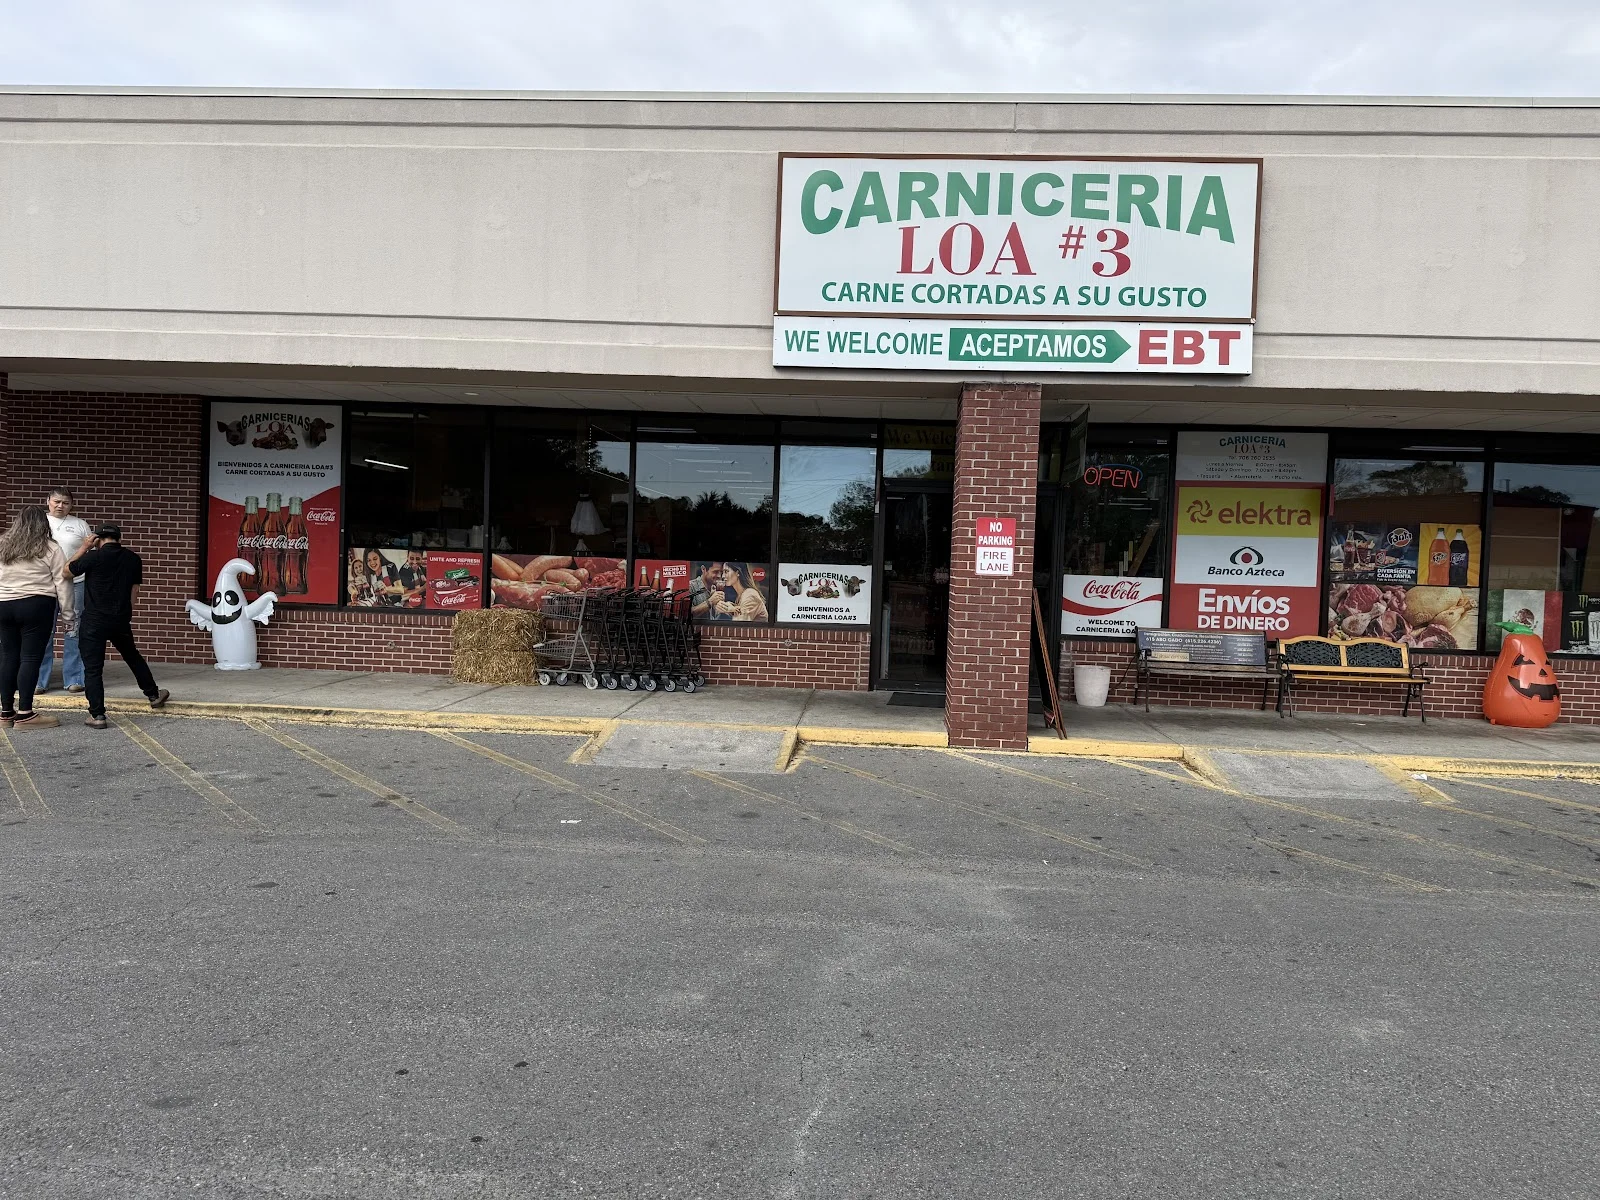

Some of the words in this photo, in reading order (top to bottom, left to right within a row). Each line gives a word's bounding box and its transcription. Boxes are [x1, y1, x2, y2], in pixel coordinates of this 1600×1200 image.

[801, 170, 1235, 244] CARNICERIA
[896, 222, 1036, 275] LOA
[821, 282, 904, 302] CARNE
[911, 283, 1046, 305] CORTADAS
[1053, 286, 1070, 305] A
[1077, 286, 1111, 306] SU
[1118, 287, 1207, 307] GUSTO
[784, 330, 819, 352] WE
[827, 331, 943, 355] WELCOME
[960, 333, 1106, 357] ACEPTAMOS
[1138, 330, 1241, 365] EBT
[241, 412, 310, 431] CARNICERIAS
[256, 421, 296, 434] LOA
[916, 430, 955, 445] Welc
[1219, 436, 1286, 448] CARNICERIA
[1234, 444, 1256, 454] LOA
[1084, 467, 1139, 488] OPEN
[307, 511, 336, 522] Coca-Cola
[1218, 501, 1312, 525] elektra
[989, 522, 1003, 532] NO
[978, 535, 1013, 546] PARKING
[983, 551, 1006, 560] FIRE
[980, 562, 1009, 571] LANE
[1207, 566, 1243, 576] Banco
[1245, 567, 1285, 577] Azteca
[798, 572, 849, 586] CARNICERIAS
[809, 578, 838, 588] LOA
[1083, 579, 1142, 600] Coca-Cola
[1198, 588, 1291, 615] Envíos
[1075, 626, 1120, 634] CARNICERIA
[1197, 615, 1221, 629] DE
[1224, 615, 1290, 631] DINERO
